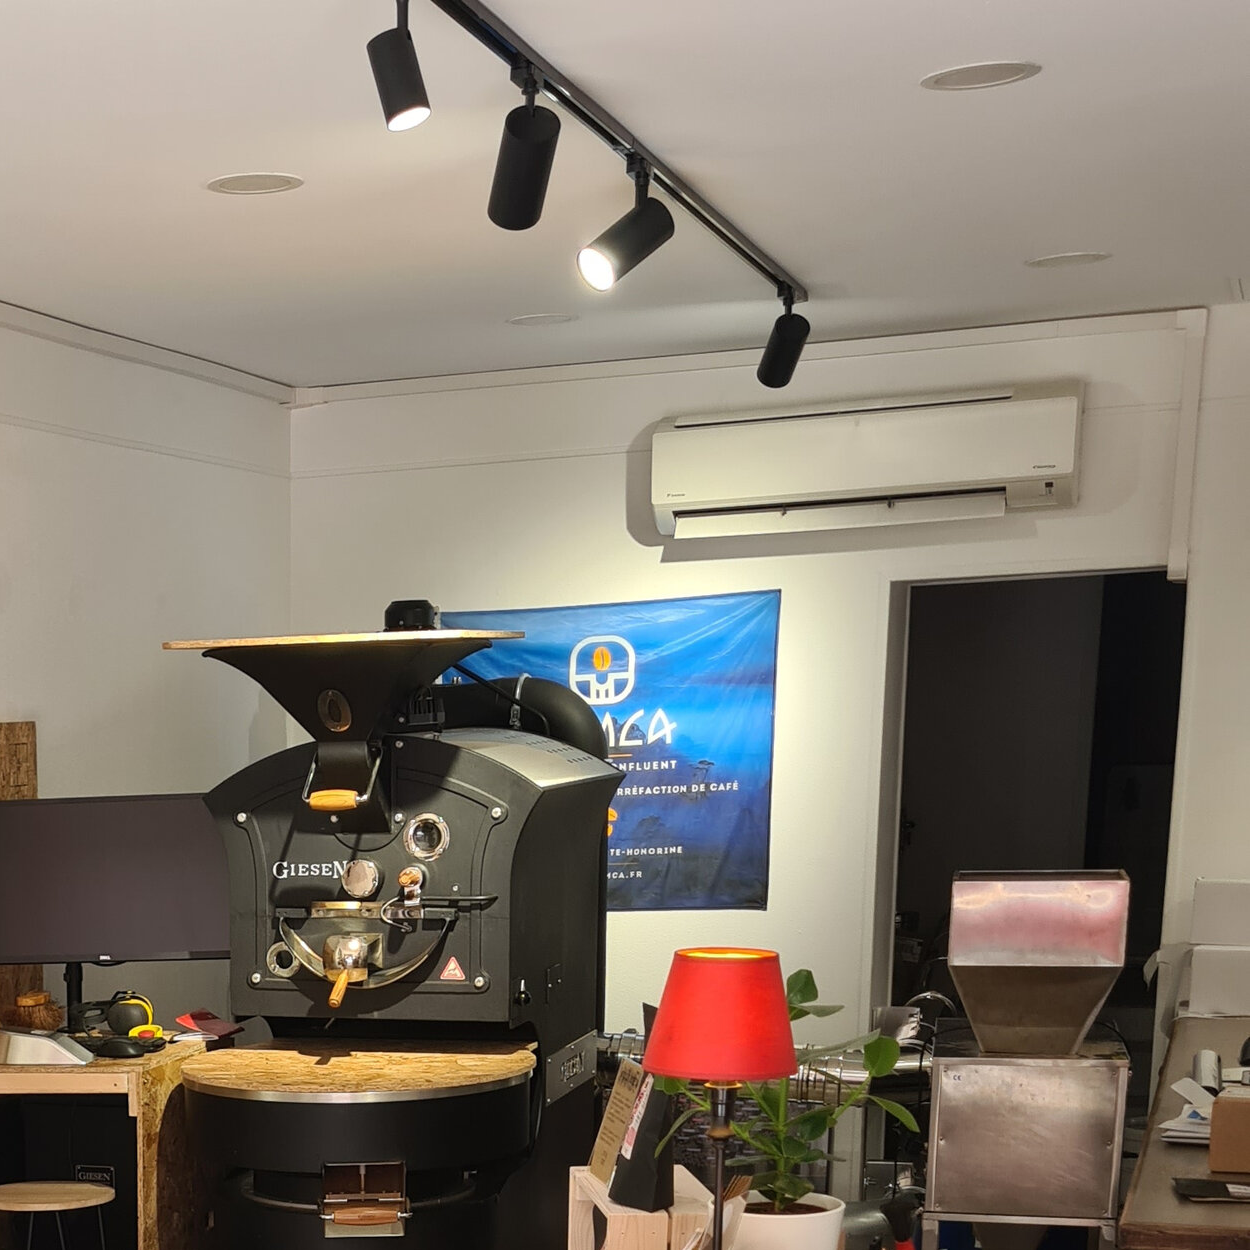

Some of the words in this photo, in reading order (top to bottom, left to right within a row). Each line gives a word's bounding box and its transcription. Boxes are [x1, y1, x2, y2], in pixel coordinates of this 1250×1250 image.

[691, 784, 706, 793] DE
[710, 780, 739, 792] CAFÉ
[272, 860, 348, 879] GIESEN
